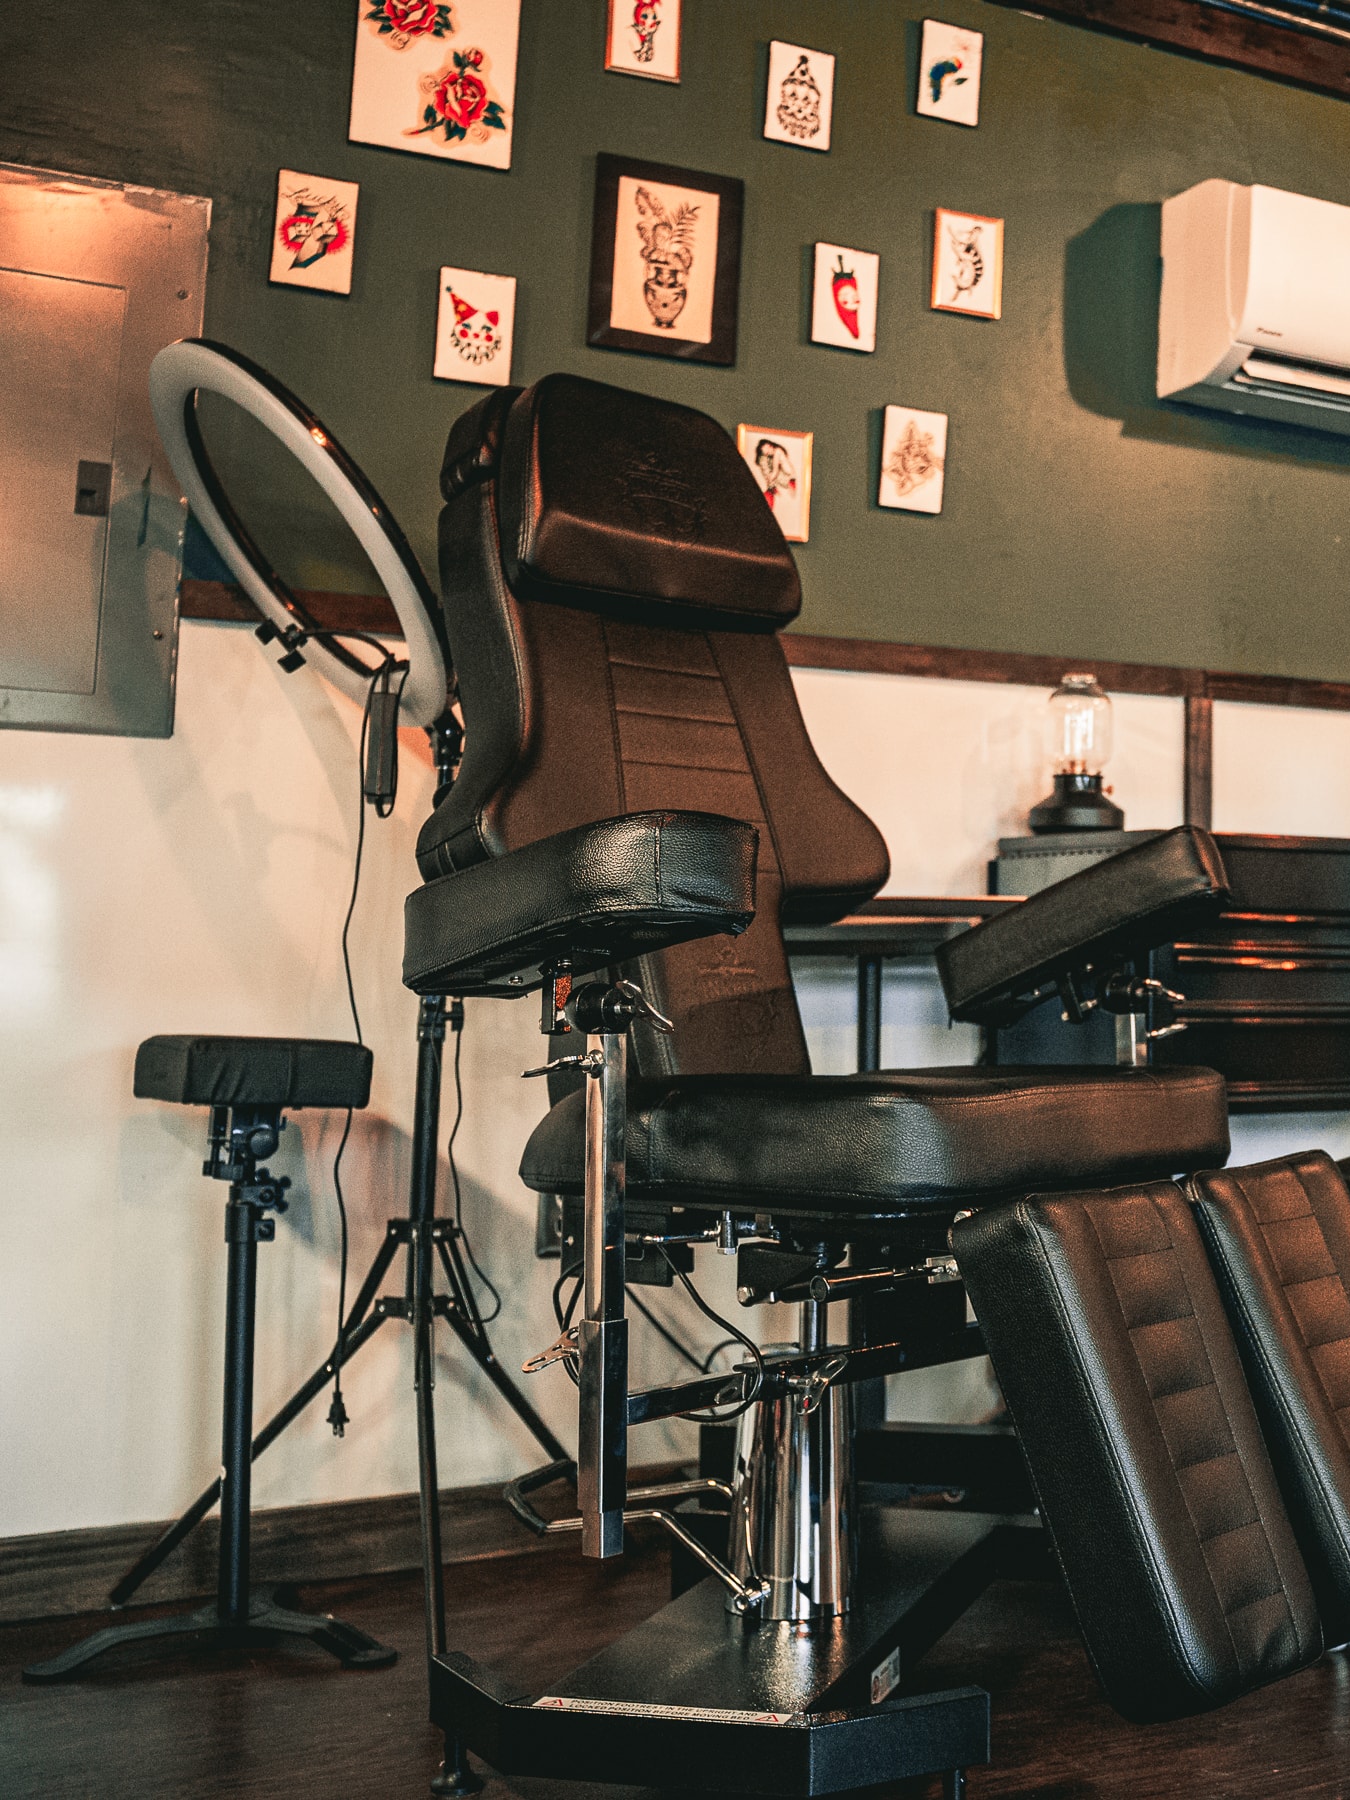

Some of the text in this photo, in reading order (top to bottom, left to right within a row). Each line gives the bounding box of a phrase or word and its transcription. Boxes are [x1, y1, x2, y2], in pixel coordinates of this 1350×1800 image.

[571, 1699, 614, 1707] POSITION
[615, 1701, 664, 1710] FOOTREST
[696, 1708, 737, 1716] UPRIGHT
[608, 1706, 651, 1714] POSITION
